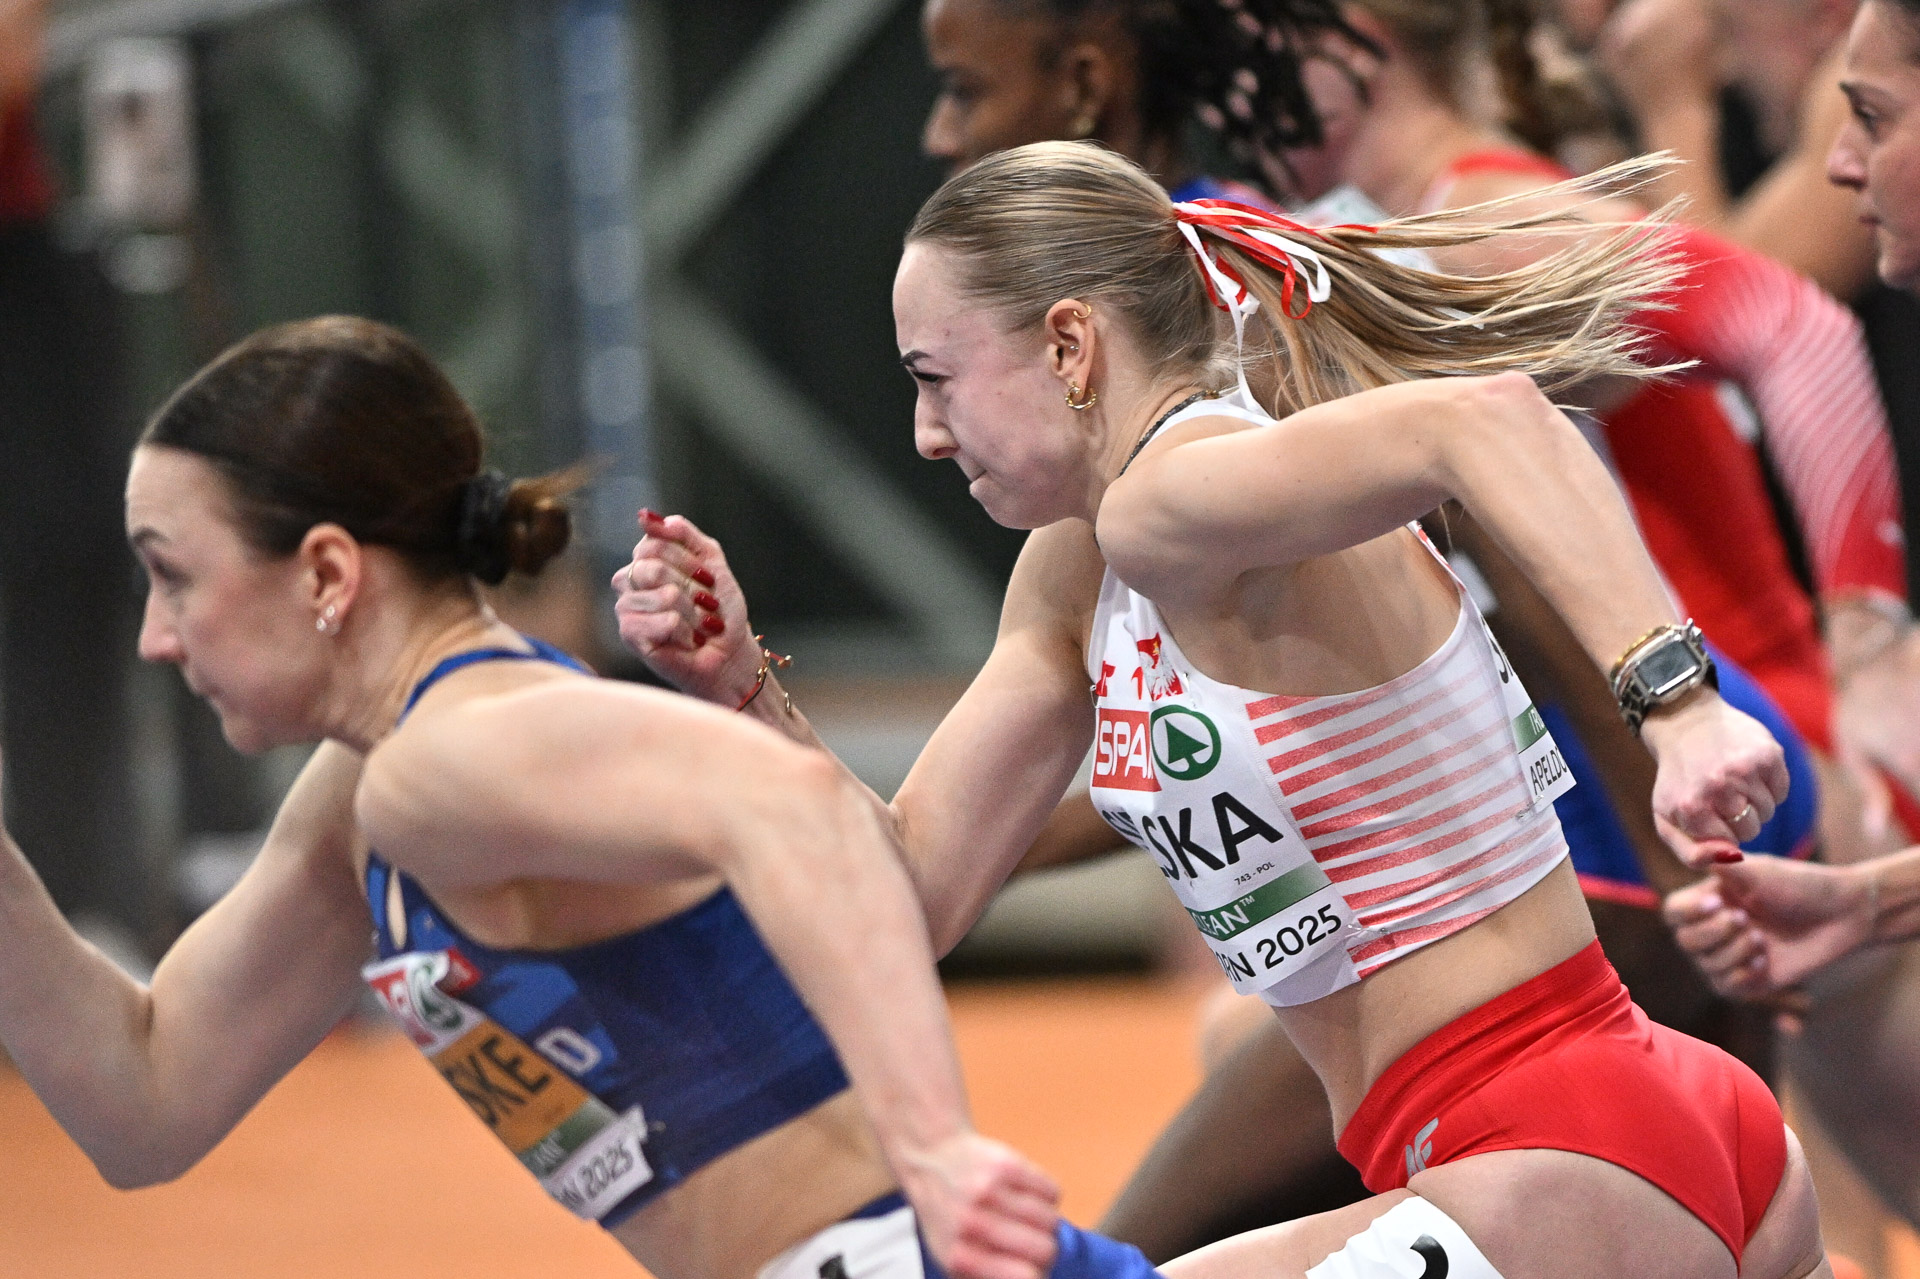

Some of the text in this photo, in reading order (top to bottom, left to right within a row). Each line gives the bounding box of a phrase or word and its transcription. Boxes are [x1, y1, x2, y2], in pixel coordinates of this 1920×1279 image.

[1096, 720, 1154, 780] SPA
[1234, 872, 1252, 886] 743
[1256, 861, 1276, 876] POL
[1256, 903, 1342, 970] 2025
